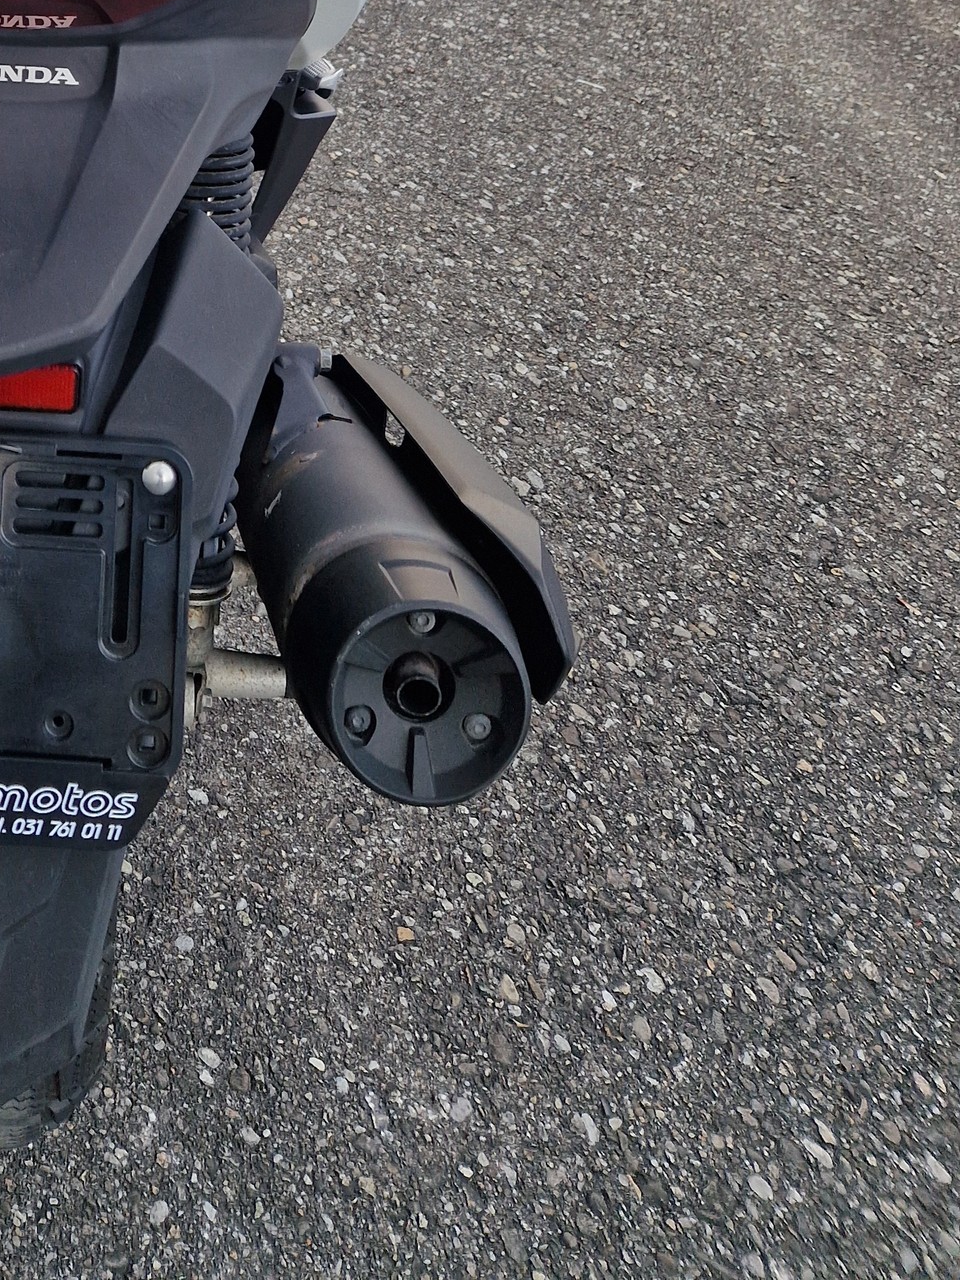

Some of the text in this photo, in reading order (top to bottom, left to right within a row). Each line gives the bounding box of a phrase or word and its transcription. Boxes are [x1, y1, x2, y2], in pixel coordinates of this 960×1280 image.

[11, 818, 44, 836] 031
[48, 820, 77, 838] 761
[81, 822, 103, 840] 01
[106, 824, 123, 841] 11
